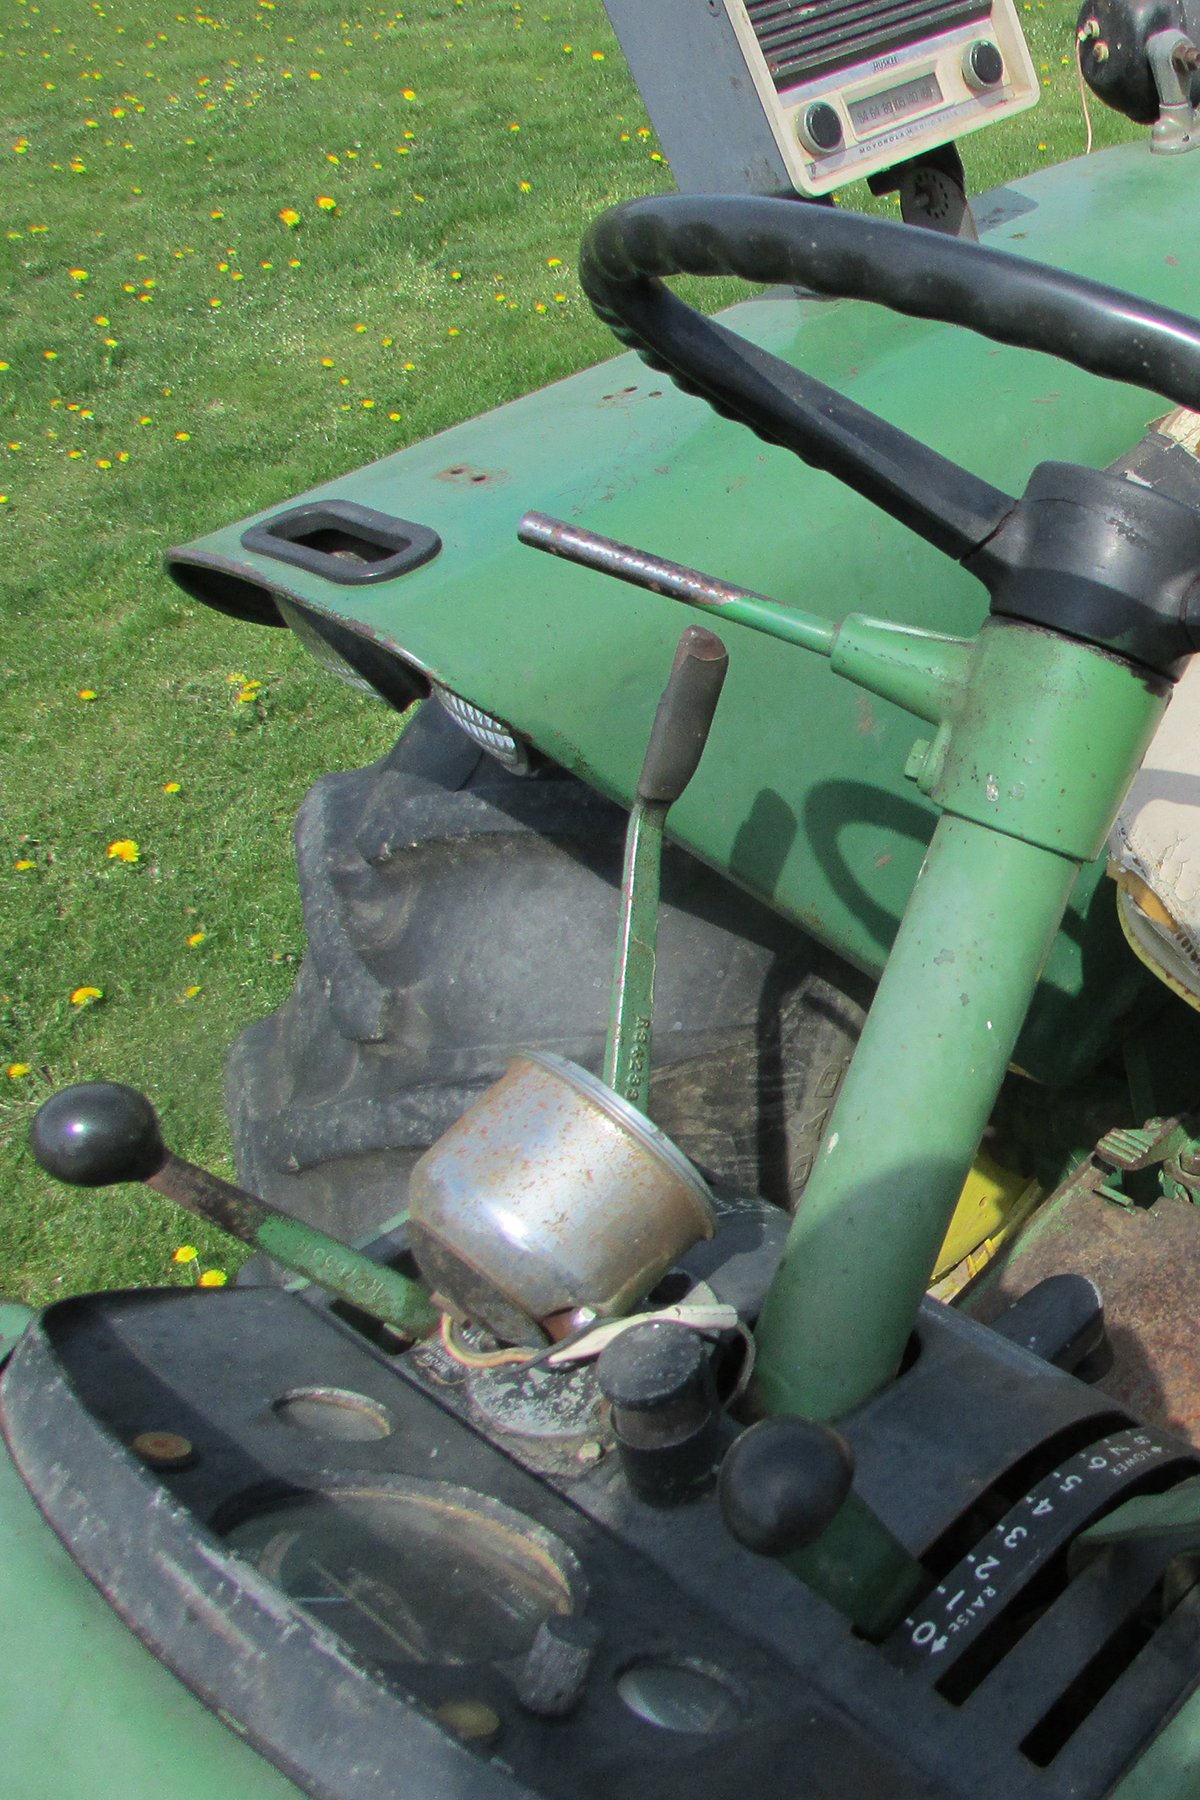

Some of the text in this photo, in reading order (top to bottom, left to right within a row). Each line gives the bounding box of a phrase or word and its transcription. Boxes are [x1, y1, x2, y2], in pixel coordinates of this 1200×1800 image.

[860, 131, 905, 153] MOTOROLA
[1109, 1450, 1152, 1476] LOWER
[975, 1555, 1000, 1580] 2
[1004, 1526, 1028, 1548] 3
[1032, 1497, 1054, 1517] 4
[1059, 1475, 1083, 1492] 5
[1088, 1456, 1108, 1470] 6
[948, 1585, 997, 1633] RAISE
